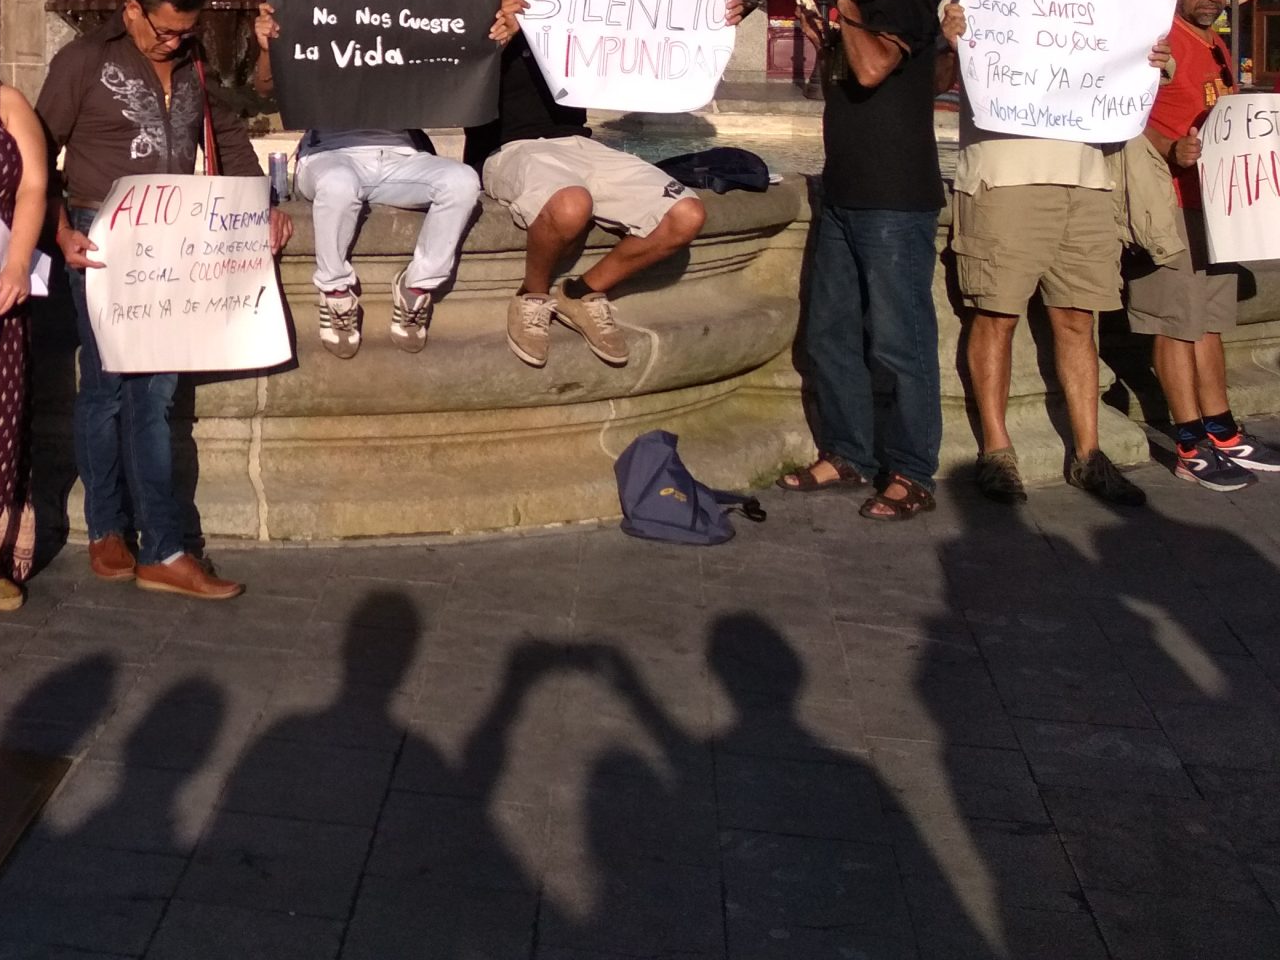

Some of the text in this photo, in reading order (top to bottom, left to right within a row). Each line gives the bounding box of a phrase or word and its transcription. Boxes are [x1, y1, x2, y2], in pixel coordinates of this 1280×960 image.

[313, 6, 337, 26] No
[355, 6, 392, 28] Nos
[294, 43, 319, 60] La
[1036, 30, 1109, 55] DUQUE
[1046, 64, 1070, 92] YA
[1080, 72, 1105, 89] DE
[110, 184, 183, 230] ALTO
[189, 257, 263, 282] COLOMBIANA
[182, 298, 200, 314] DE
